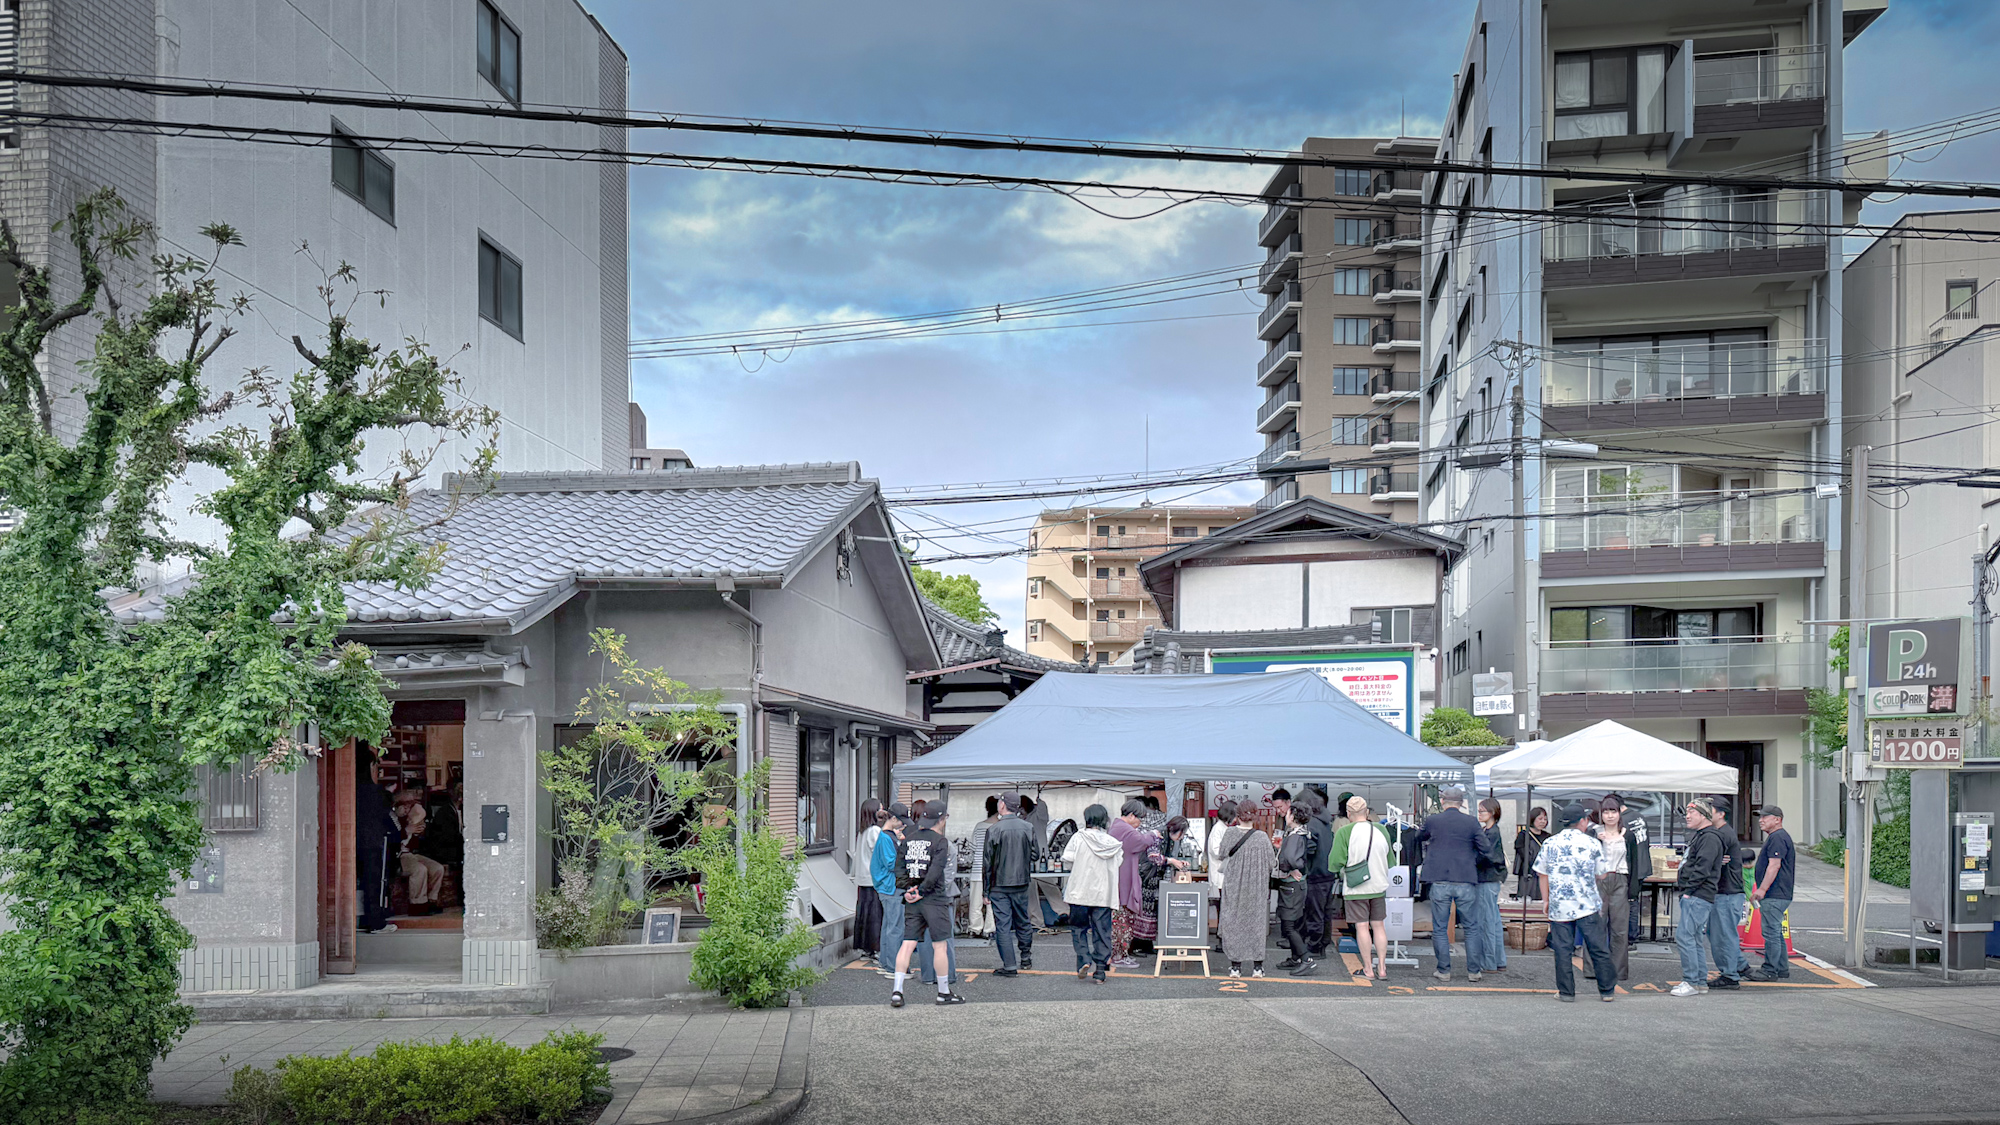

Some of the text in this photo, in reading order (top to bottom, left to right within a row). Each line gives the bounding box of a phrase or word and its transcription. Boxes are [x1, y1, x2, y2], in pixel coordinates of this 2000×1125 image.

[1887, 629, 1927, 682] P
[1903, 662, 1937, 680] 24h
[1475, 700, 1512, 711] 自転車を除く
[1930, 686, 1953, 710] 満
[1886, 727, 1959, 738] 昼間最大料金
[1885, 740, 1960, 761] 1200円
